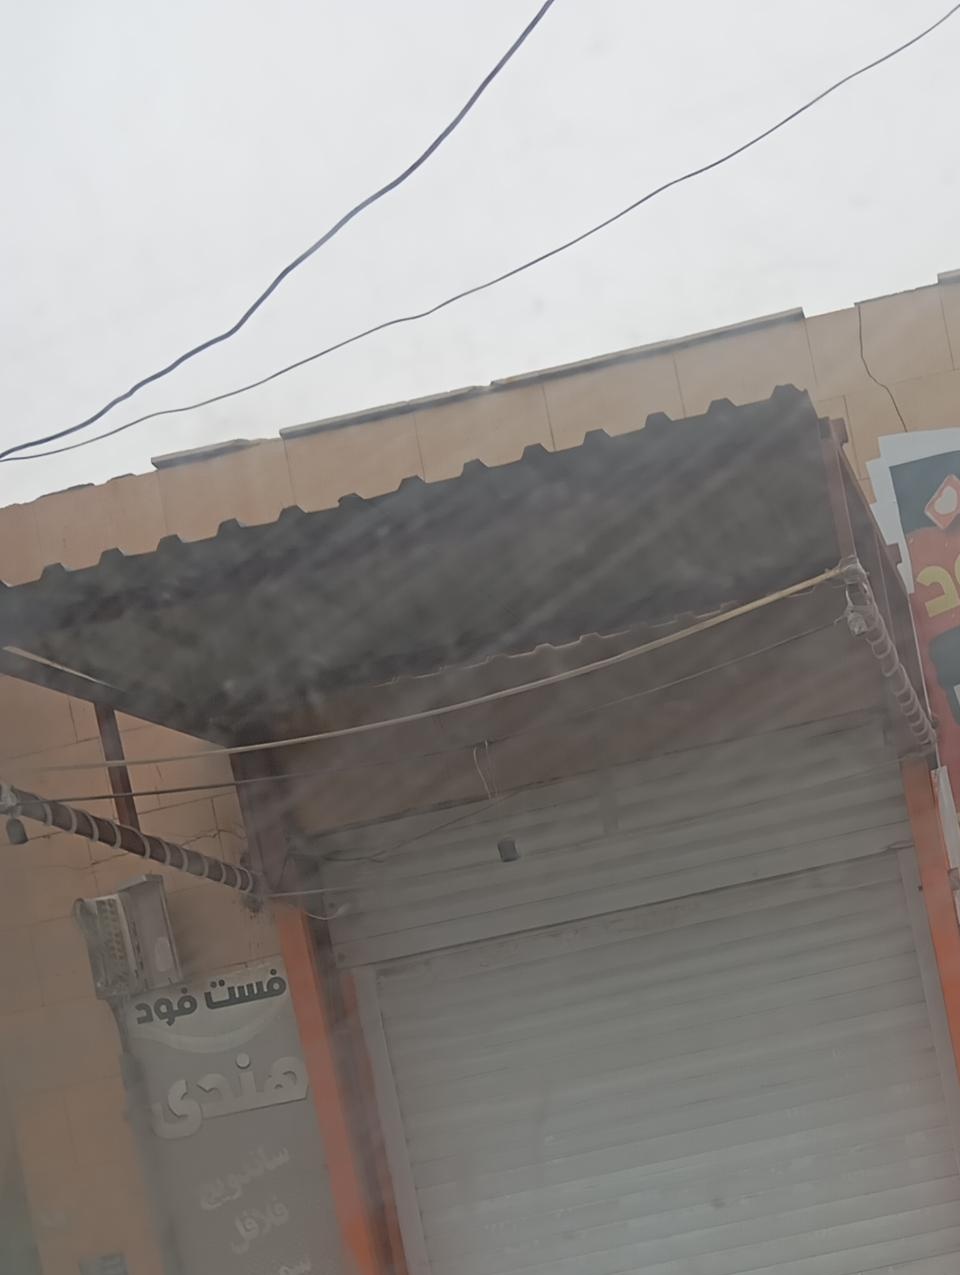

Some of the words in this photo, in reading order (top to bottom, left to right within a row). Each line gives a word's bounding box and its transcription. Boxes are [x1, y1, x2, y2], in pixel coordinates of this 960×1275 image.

[134, 986, 199, 1027] فود
[203, 967, 288, 1011] فست
[150, 1052, 311, 1141] هندی
